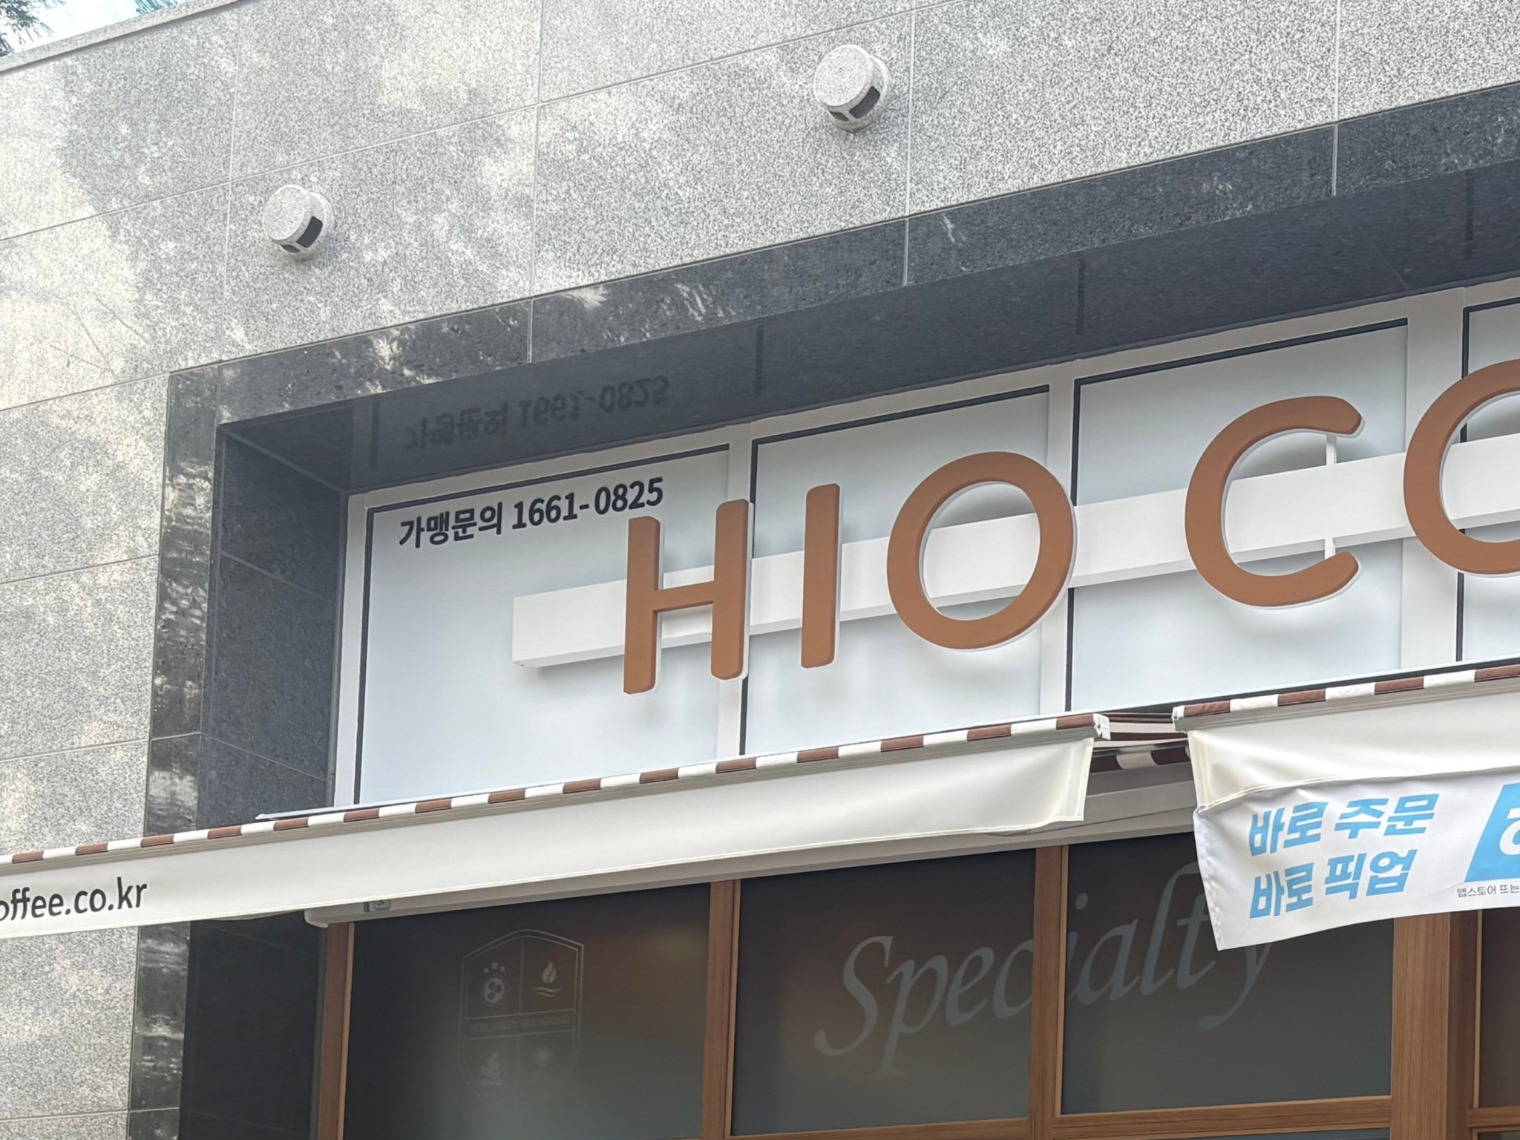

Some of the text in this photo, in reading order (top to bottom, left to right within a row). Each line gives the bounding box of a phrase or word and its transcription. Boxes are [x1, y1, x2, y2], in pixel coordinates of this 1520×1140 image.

[399, 476, 664, 549] 가맹문의 1661-0825
[622, 450, 1076, 696] HIO
[1249, 793, 1440, 857] 바로 주문
[1249, 849, 1418, 919] 바로 픽업
